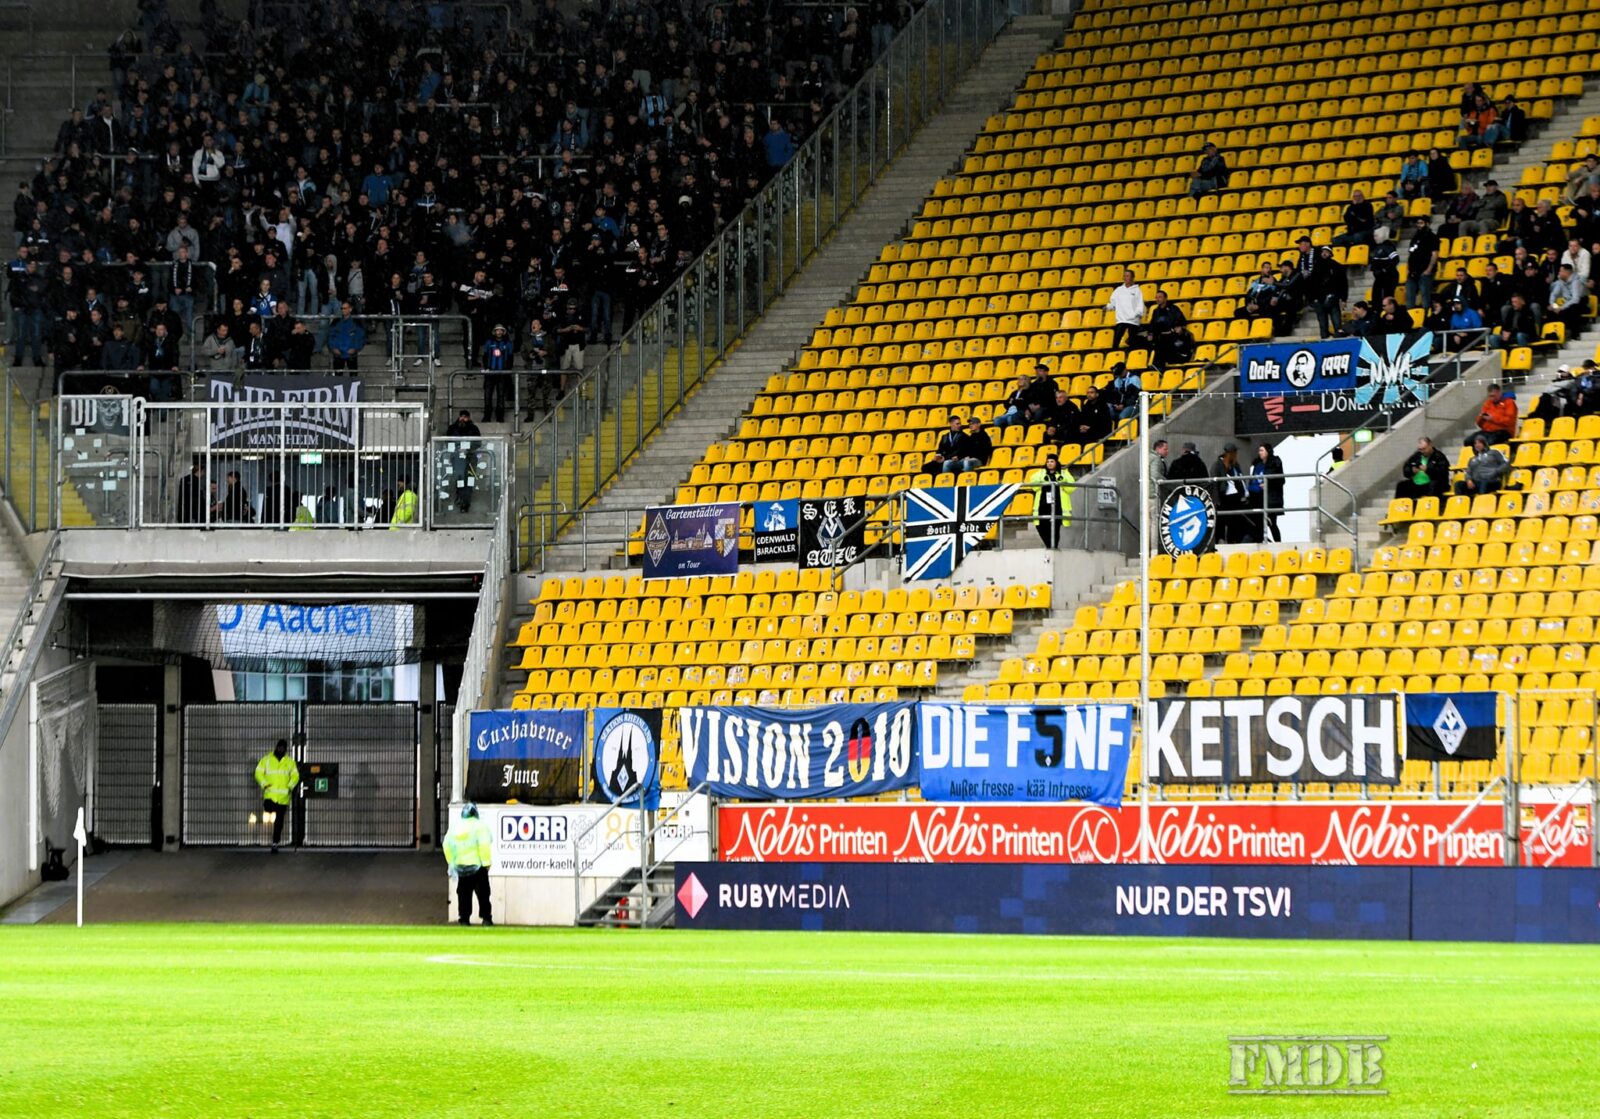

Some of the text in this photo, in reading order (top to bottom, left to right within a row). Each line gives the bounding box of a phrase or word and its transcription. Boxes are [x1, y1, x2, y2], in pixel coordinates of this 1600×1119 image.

[1250, 360, 1280, 380] DoPa
[1321, 355, 1350, 376] 1999
[1370, 351, 1411, 387] NWA
[210, 379, 361, 430] THE FIRM
[247, 434, 319, 445] MANNHEIM
[665, 505, 724, 520] Gartenstädtler
[959, 523, 980, 533] Side
[756, 533, 796, 545] ODENWALD
[756, 544, 796, 556] BARACKLER
[477, 720, 572, 751] Cuxhavener
[680, 707, 912, 789] VISION 2010
[921, 704, 1128, 771] DIE F5NF
[1148, 696, 1397, 779] KETSCH
[502, 764, 539, 788] Jung
[503, 816, 566, 841] DORR
[725, 806, 888, 862] Nobis Printen
[892, 806, 1064, 863] Nobis Printen
[1122, 805, 1305, 864] Nobis Printen
[1311, 804, 1420, 865] Nobis
[718, 883, 851, 909] RUBYMEDIA
[1116, 885, 1291, 917] NUR DER TSV!
